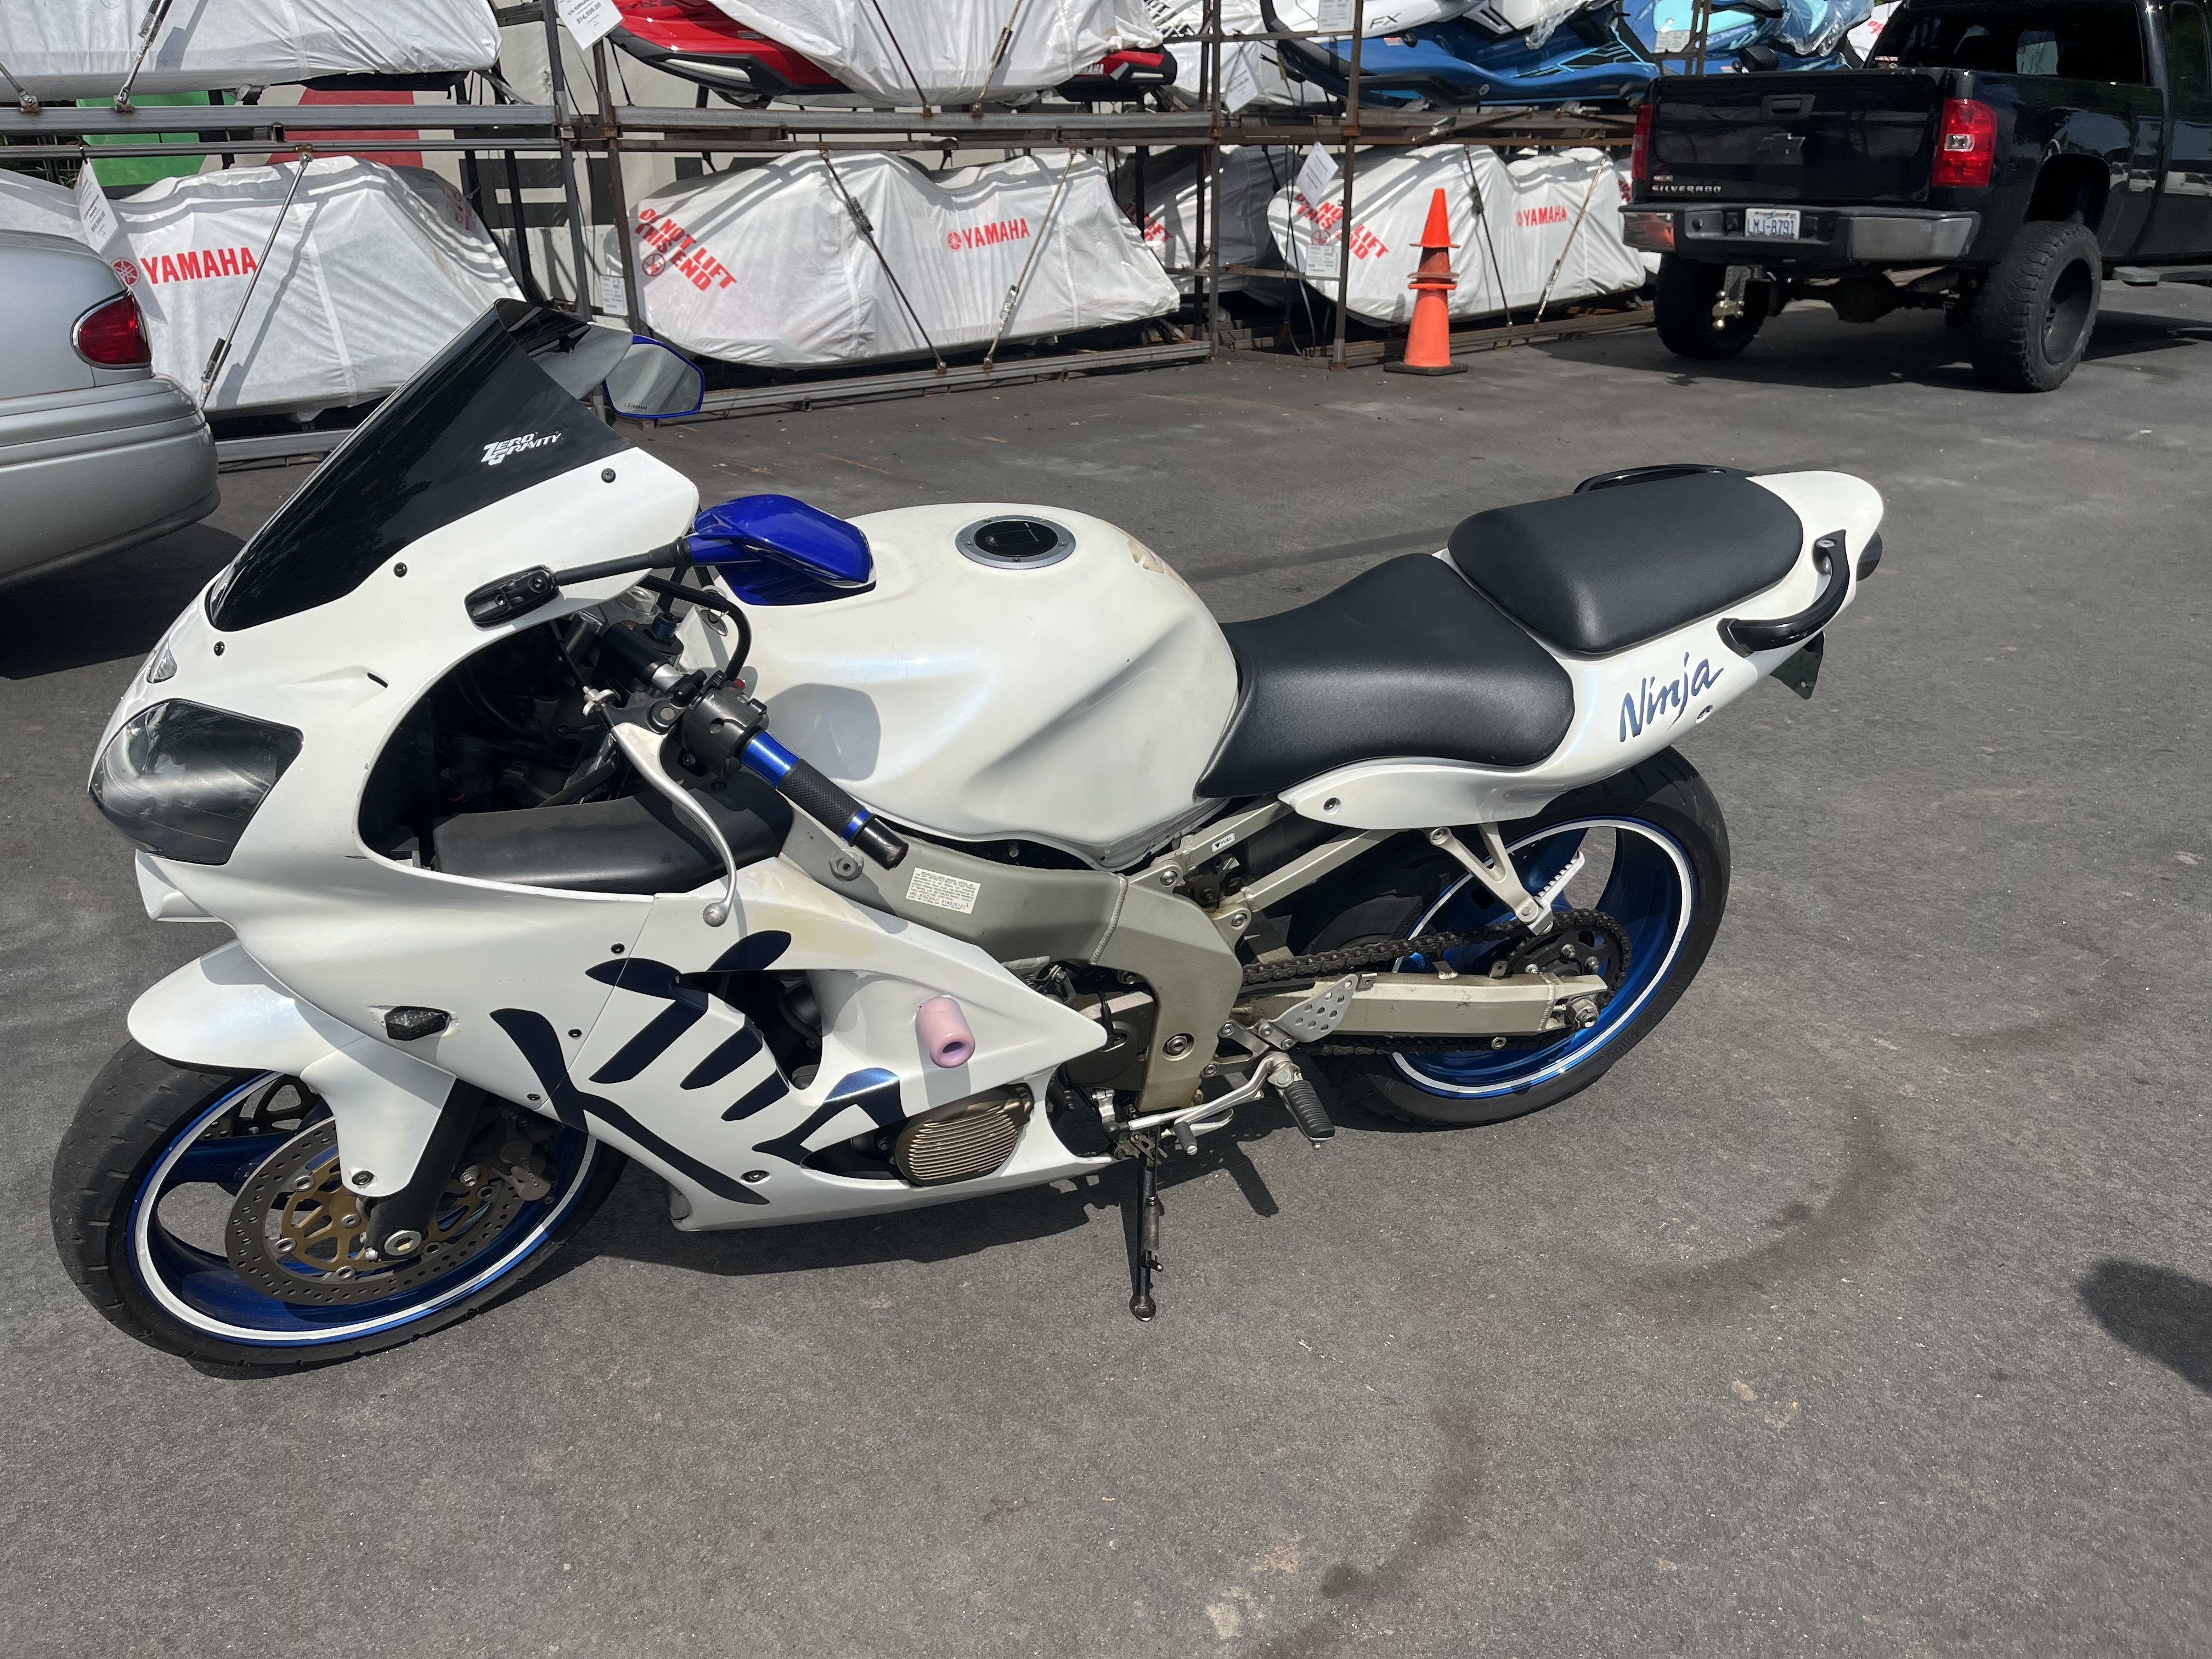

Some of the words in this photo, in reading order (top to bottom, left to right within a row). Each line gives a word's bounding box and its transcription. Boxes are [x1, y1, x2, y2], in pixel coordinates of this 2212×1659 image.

[1369, 12, 1401, 29] FX
[1651, 185, 1722, 194] SILVERADO
[1319, 201, 1344, 221] NO
[1354, 224, 1389, 258] LIFT
[1522, 205, 1567, 227] YAMAHA
[962, 218, 1031, 249] YAMAHA
[140, 247, 258, 285] YAMAHA
[659, 218, 697, 251] NOT
[692, 246, 737, 289] LIFT
[669, 249, 712, 291] END
[481, 433, 535, 462] ZERO
[488, 432, 562, 466] GRAVITY
[1619, 651, 1725, 743] Ninja
[1220, 837, 1233, 845] FUEL
